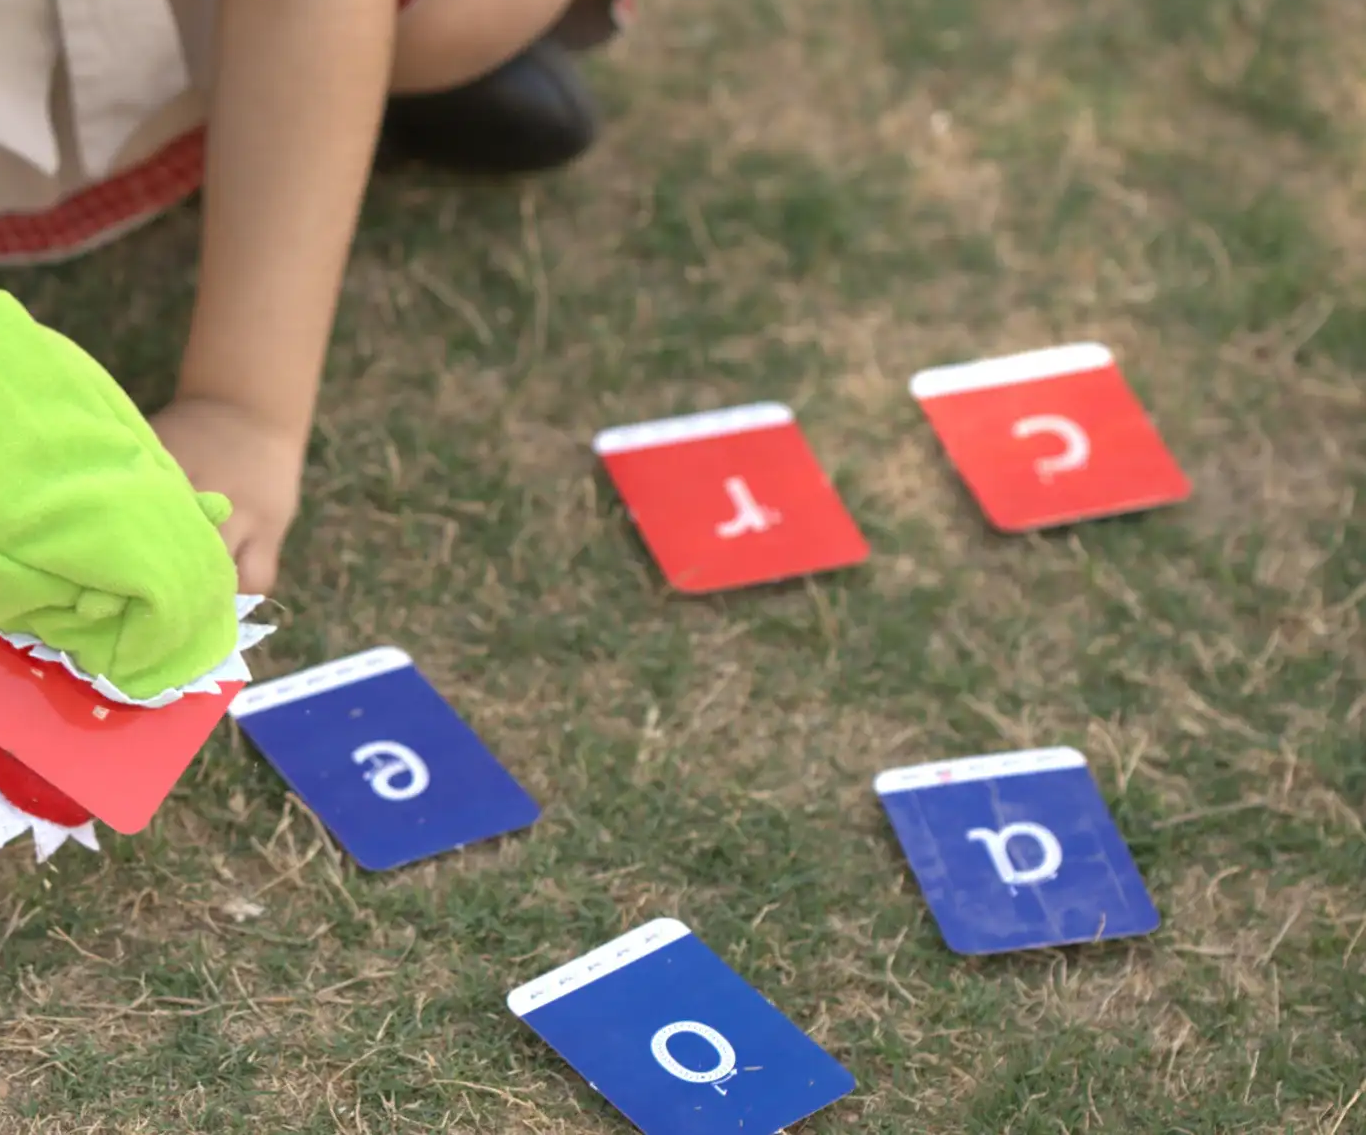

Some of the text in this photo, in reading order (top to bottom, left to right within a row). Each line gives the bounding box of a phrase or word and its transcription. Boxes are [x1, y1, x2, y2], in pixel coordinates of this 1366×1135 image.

[1013, 414, 1090, 472] c
[717, 476, 771, 537] r
[352, 740, 429, 800] e
[966, 822, 1063, 884] a
[650, 1020, 736, 1083] o
